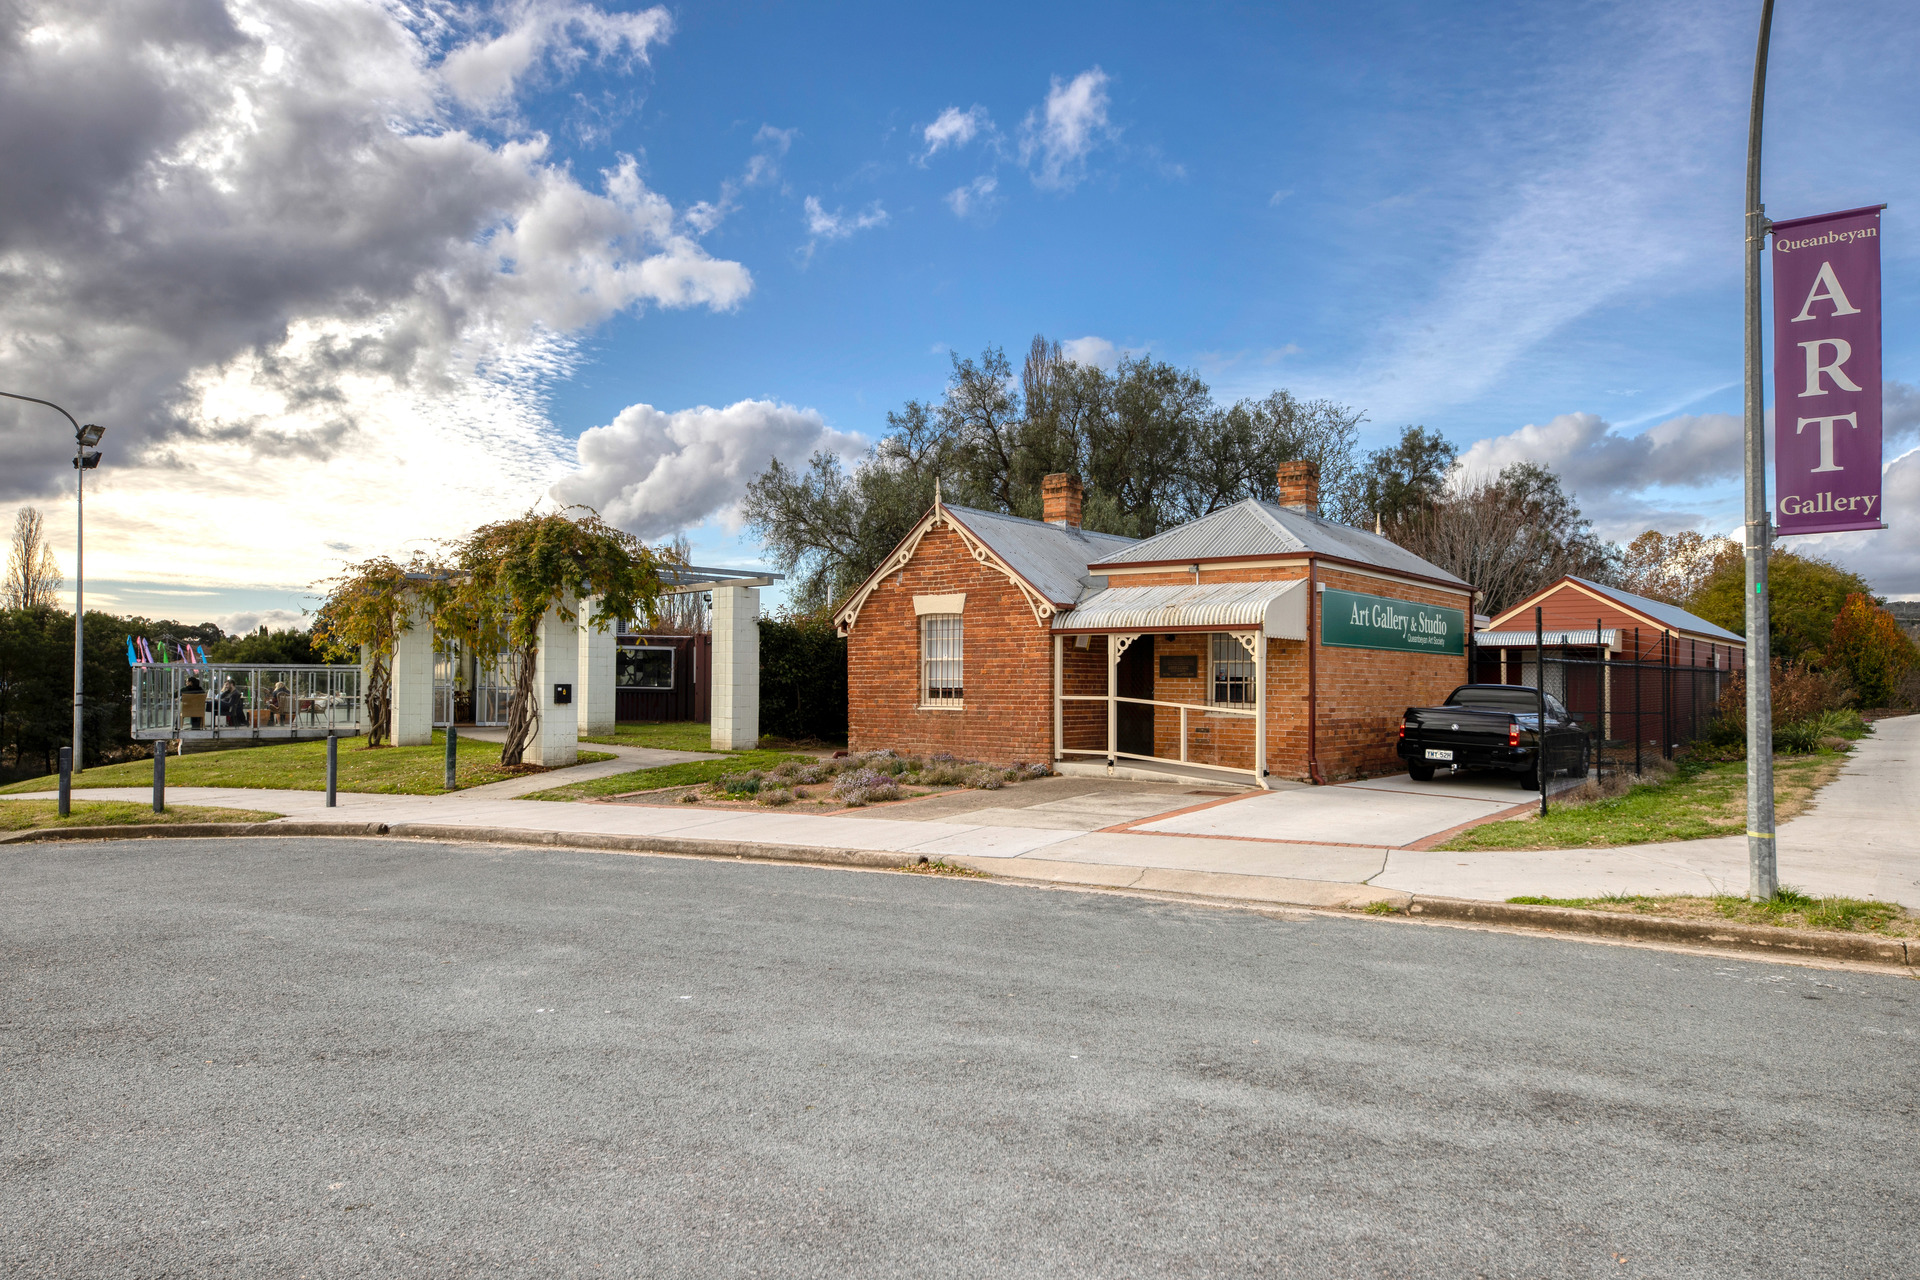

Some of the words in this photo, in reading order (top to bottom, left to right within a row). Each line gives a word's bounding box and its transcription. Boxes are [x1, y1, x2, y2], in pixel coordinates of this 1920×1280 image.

[1776, 227, 1877, 252] Queanbeyan
[1790, 261, 1862, 472] ART
[1780, 491, 1878, 516] Gallery
[1350, 601, 1370, 626] Art
[1372, 604, 1409, 639] Gallery
[1410, 617, 1417, 632] &
[1419, 612, 1447, 635] Studio
